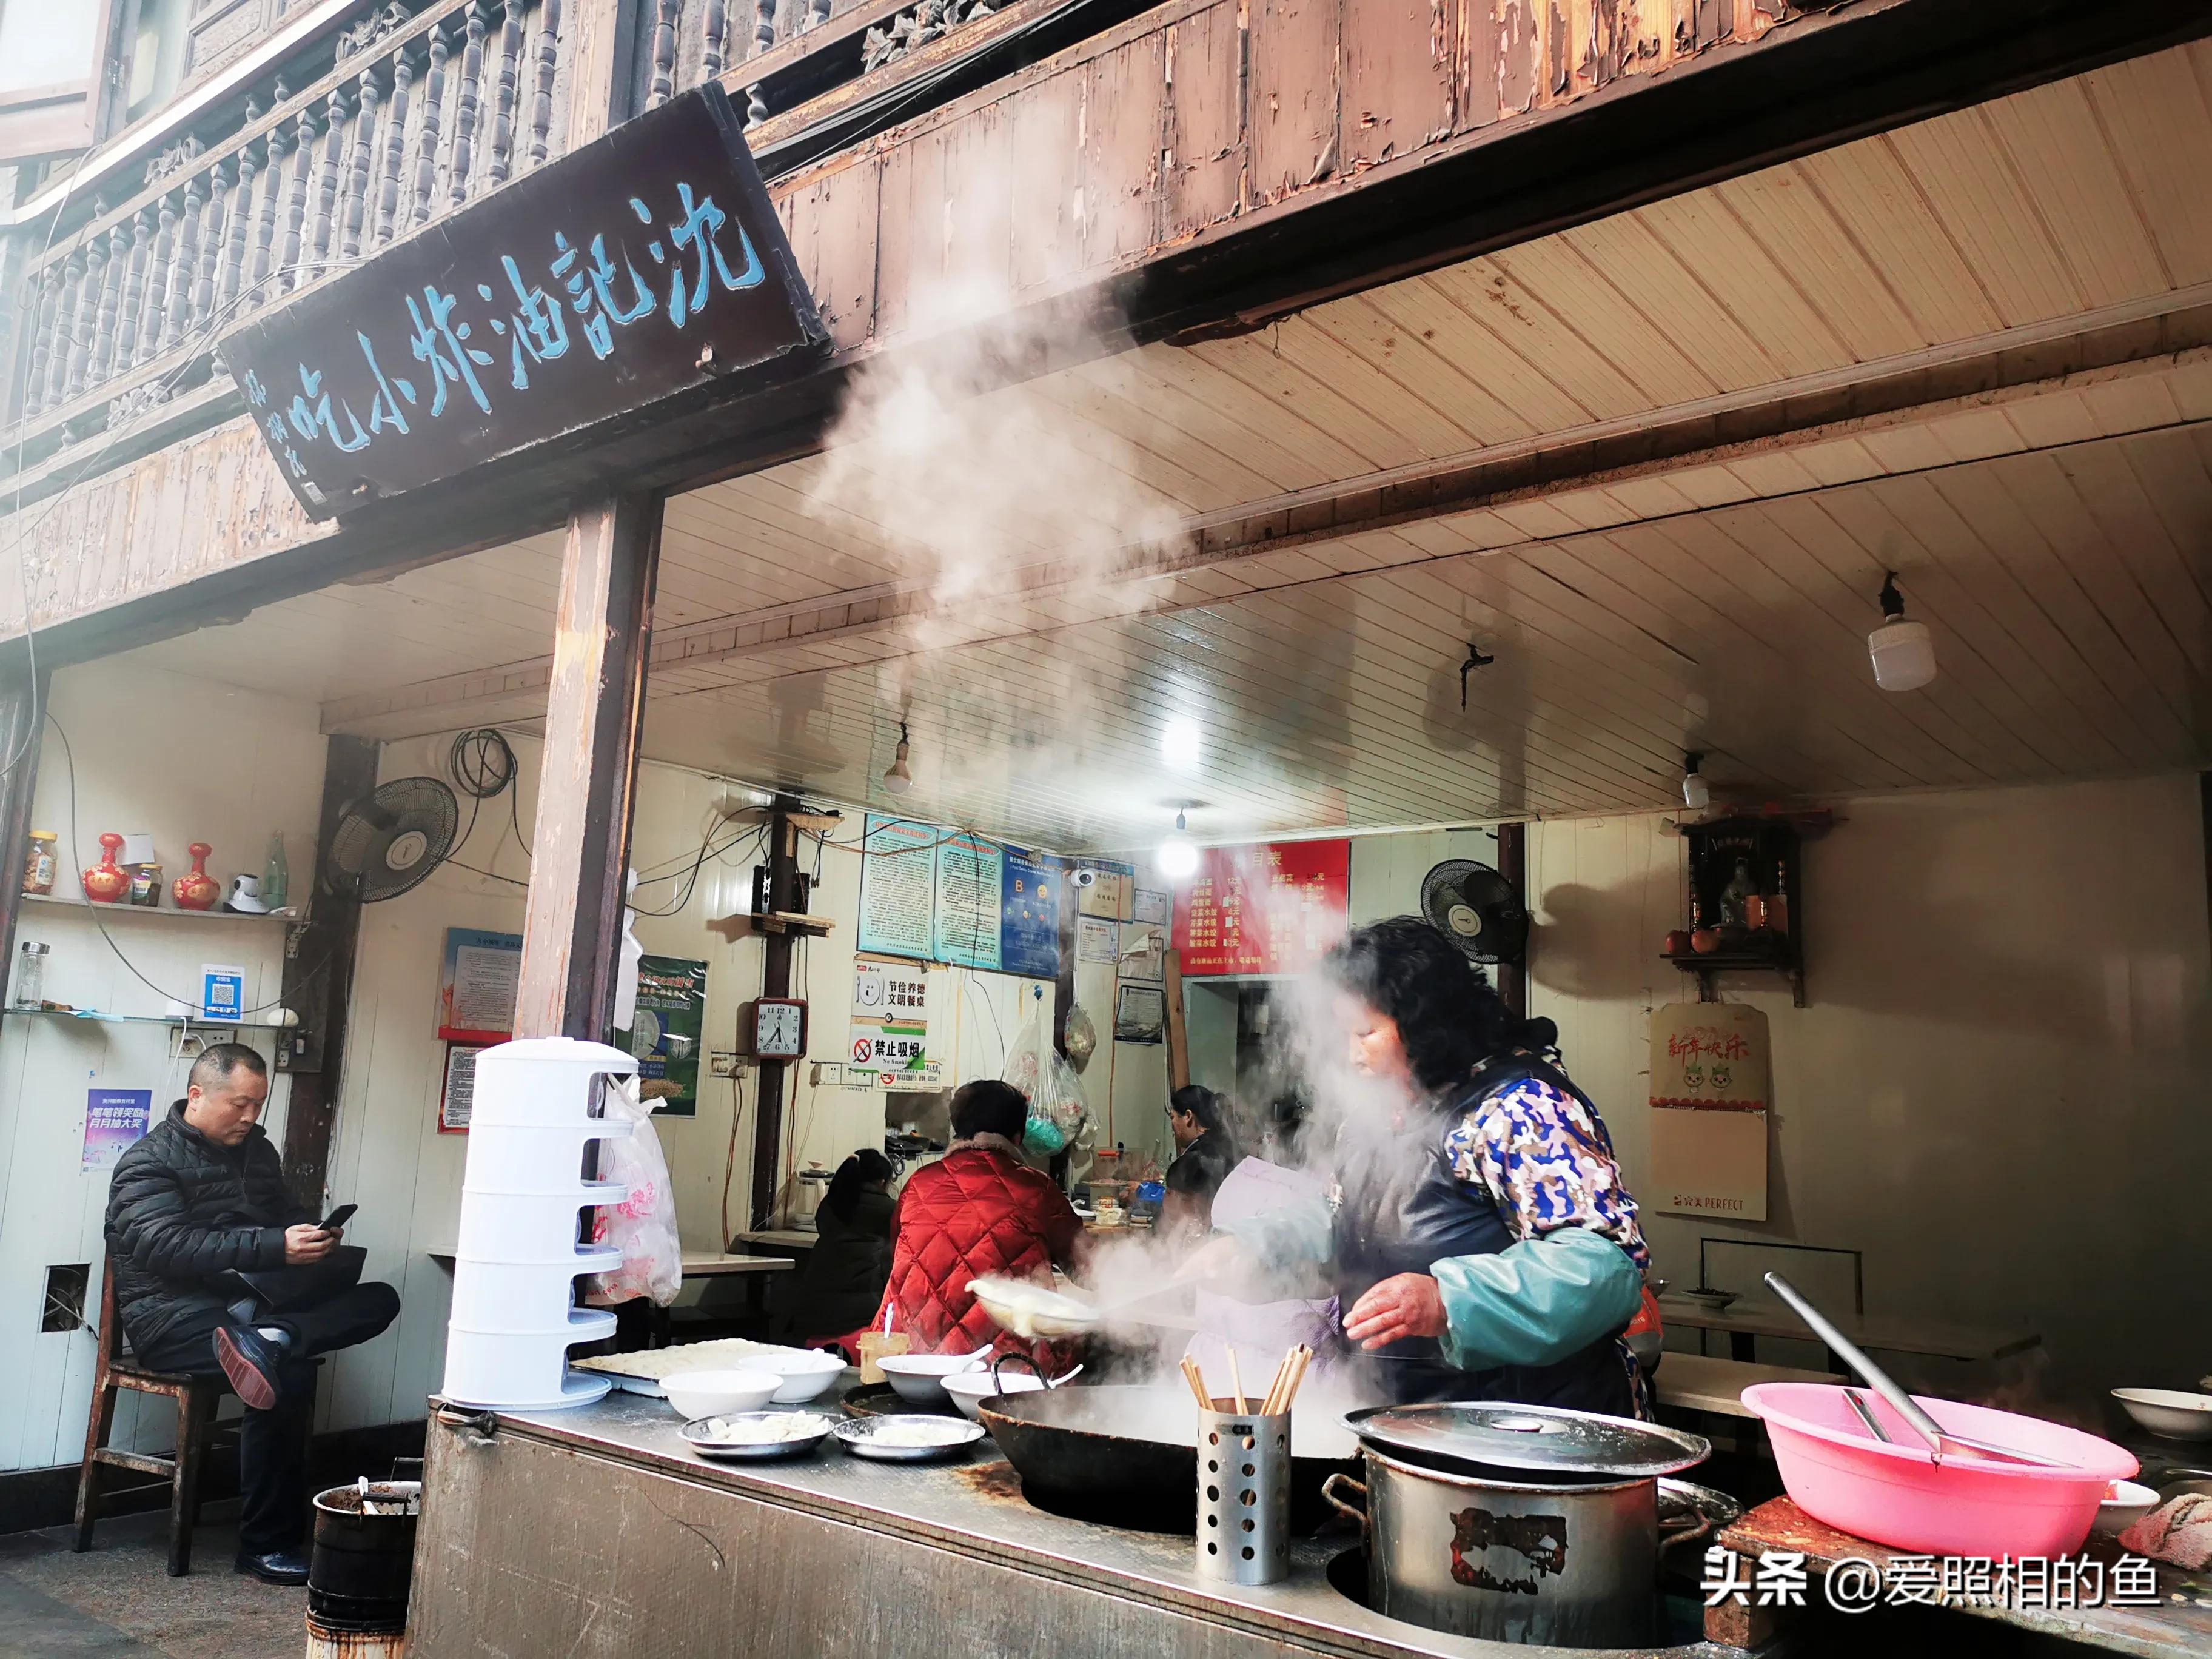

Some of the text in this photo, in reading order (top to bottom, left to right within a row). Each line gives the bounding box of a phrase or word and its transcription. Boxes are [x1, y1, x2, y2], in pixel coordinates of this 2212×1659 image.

[889, 980, 925, 994] 节俭养德
[888, 994, 924, 1007] 文明餐桌
[875, 1039, 919, 1058] 禁止吸烟
[1668, 1033, 1750, 1068] 新年快乐
[89, 1118, 142, 1128] 月月抽大奖
[1705, 1197, 1743, 1211] PERFECT
